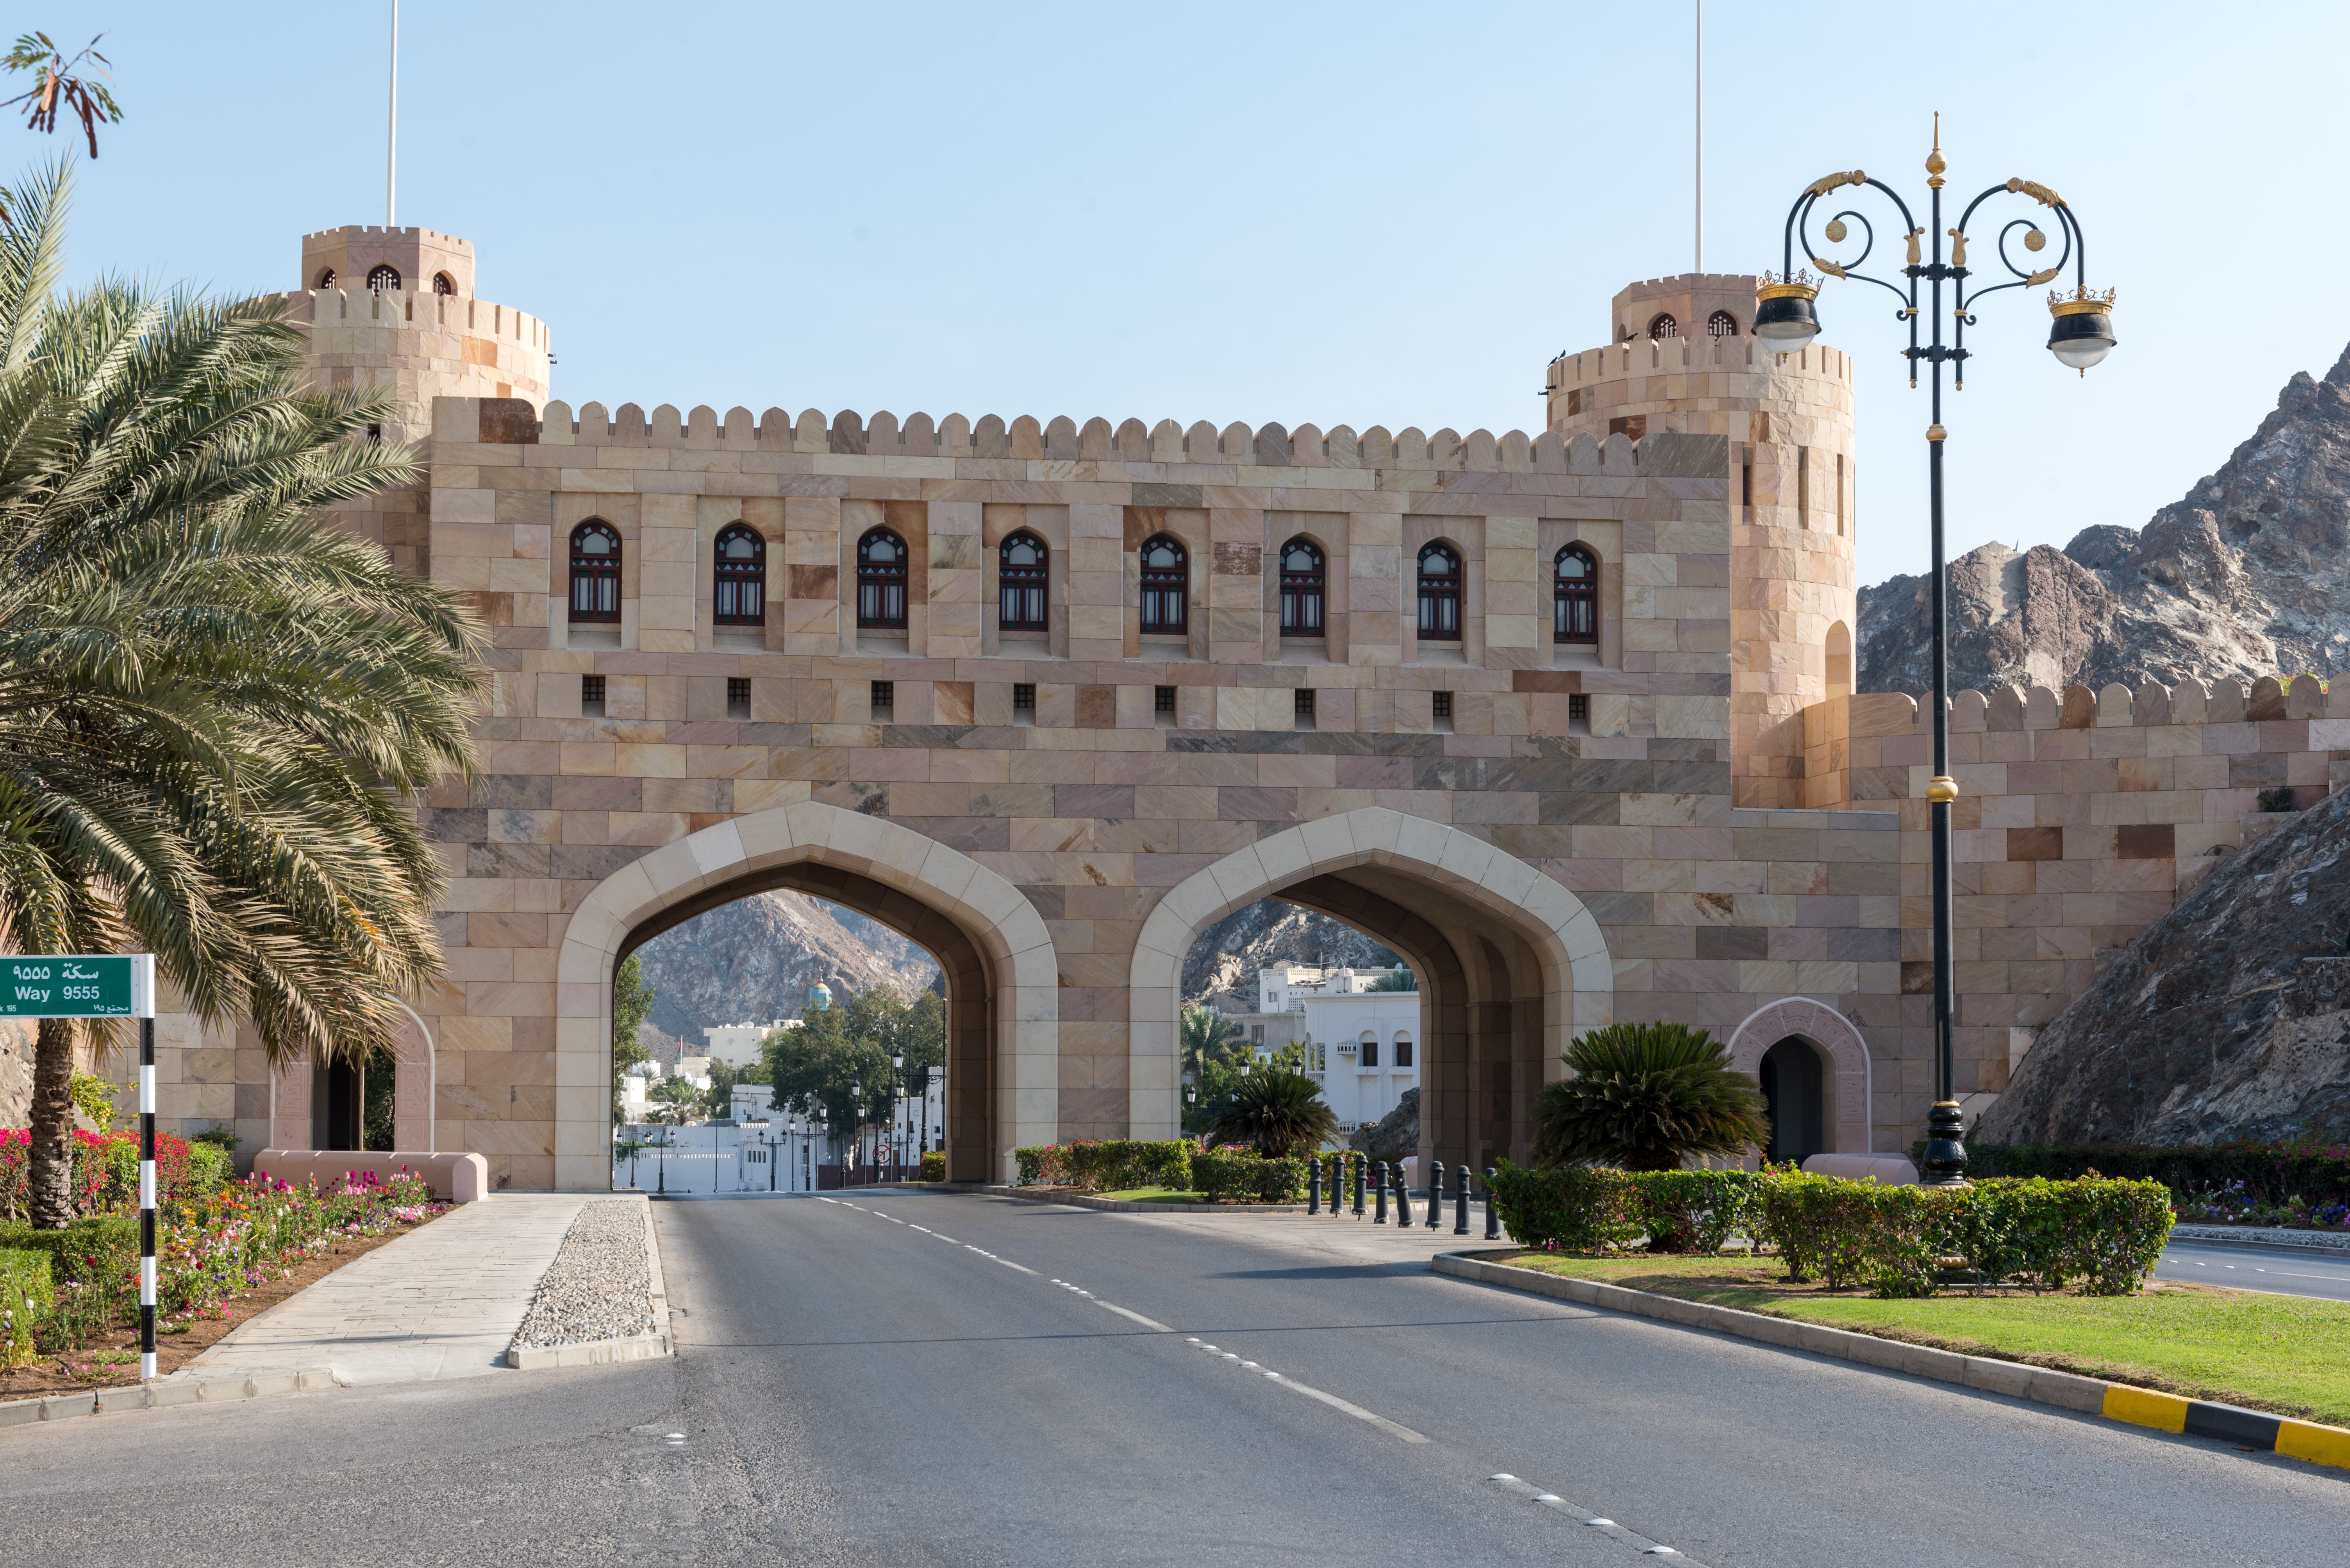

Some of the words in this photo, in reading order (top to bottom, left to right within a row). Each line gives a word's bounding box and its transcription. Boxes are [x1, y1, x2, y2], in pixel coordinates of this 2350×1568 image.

[13, 965, 50, 980] ٩٥٥٥
[62, 963, 99, 979] سكة
[15, 986, 50, 1002] Way
[63, 986, 100, 999] 9555
